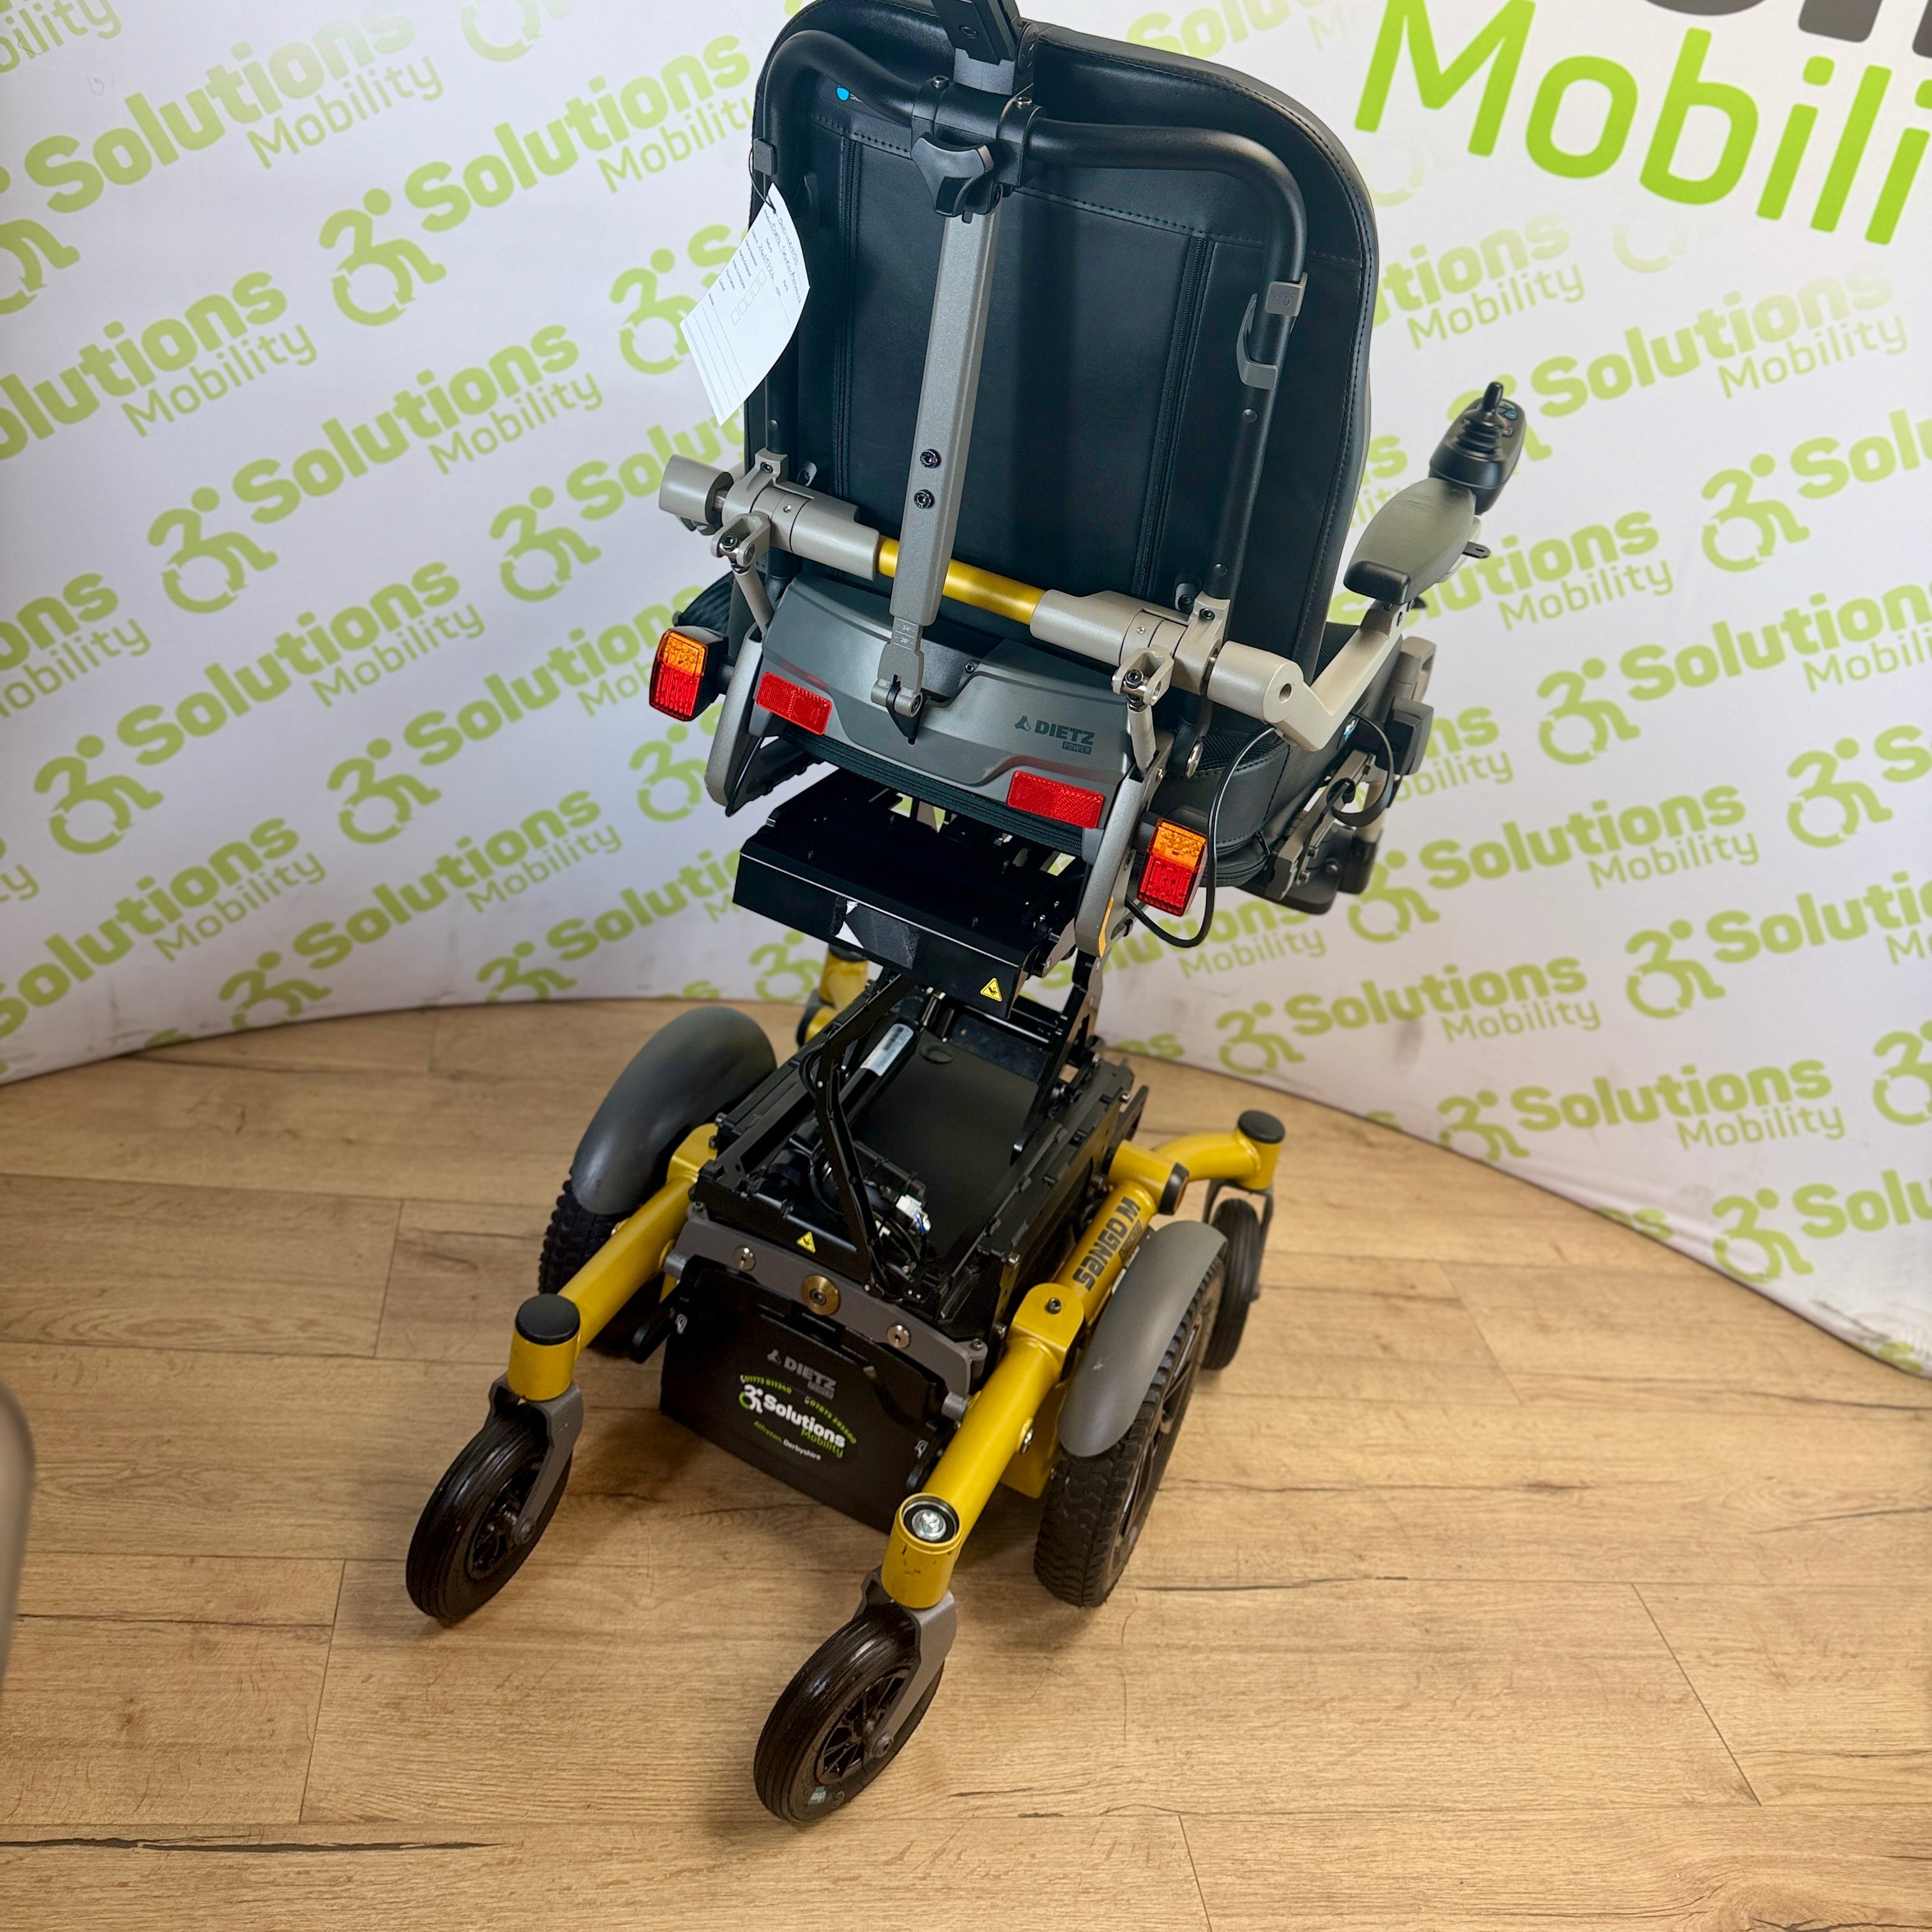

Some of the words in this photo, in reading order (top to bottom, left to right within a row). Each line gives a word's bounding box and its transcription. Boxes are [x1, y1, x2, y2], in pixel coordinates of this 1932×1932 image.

[24, 13, 415, 213] Solutions
[247, 56, 443, 169] Mobility
[404, 34, 750, 233] Solutions
[1354, 0, 1932, 245] Mobili
[1407, 263, 1586, 349] Mobility
[1531, 267, 1894, 418] Solutions
[121, 324, 318, 437] Mobility
[1718, 315, 1909, 399] Mobility
[232, 325, 579, 524] Solutions
[428, 372, 602, 475] Mobility
[1499, 560, 1674, 631] Mobility
[0, 618, 151, 717] obility
[116, 562, 459, 765] Solutions
[310, 604, 486, 707] Mobility
[1620, 583, 1932, 701] Solution
[1034, 720, 1096, 746] DIETZ
[1062, 742, 1092, 754] POWER
[293, 790, 601, 970] Solutions
[464, 825, 622, 913] Mobility
[1420, 785, 1746, 889] Solutions
[1588, 832, 1760, 889] Mobility
[153, 853, 326, 962] Mobility
[1177, 930, 1327, 979] Mobility
[1284, 956, 1587, 1036] Solutions
[1441, 1000, 1602, 1043] Mobility
[1509, 1059, 1832, 1131] Solutions
[1676, 1106, 1846, 1151] Mobility
[1116, 1197, 1141, 1223] M
[784, 1356, 836, 1389] DIETZ
[763, 1393, 846, 1448] Solutions
[783, 1438, 822, 1461] Derbyshire
[801, 1428, 844, 1459] Mobility
